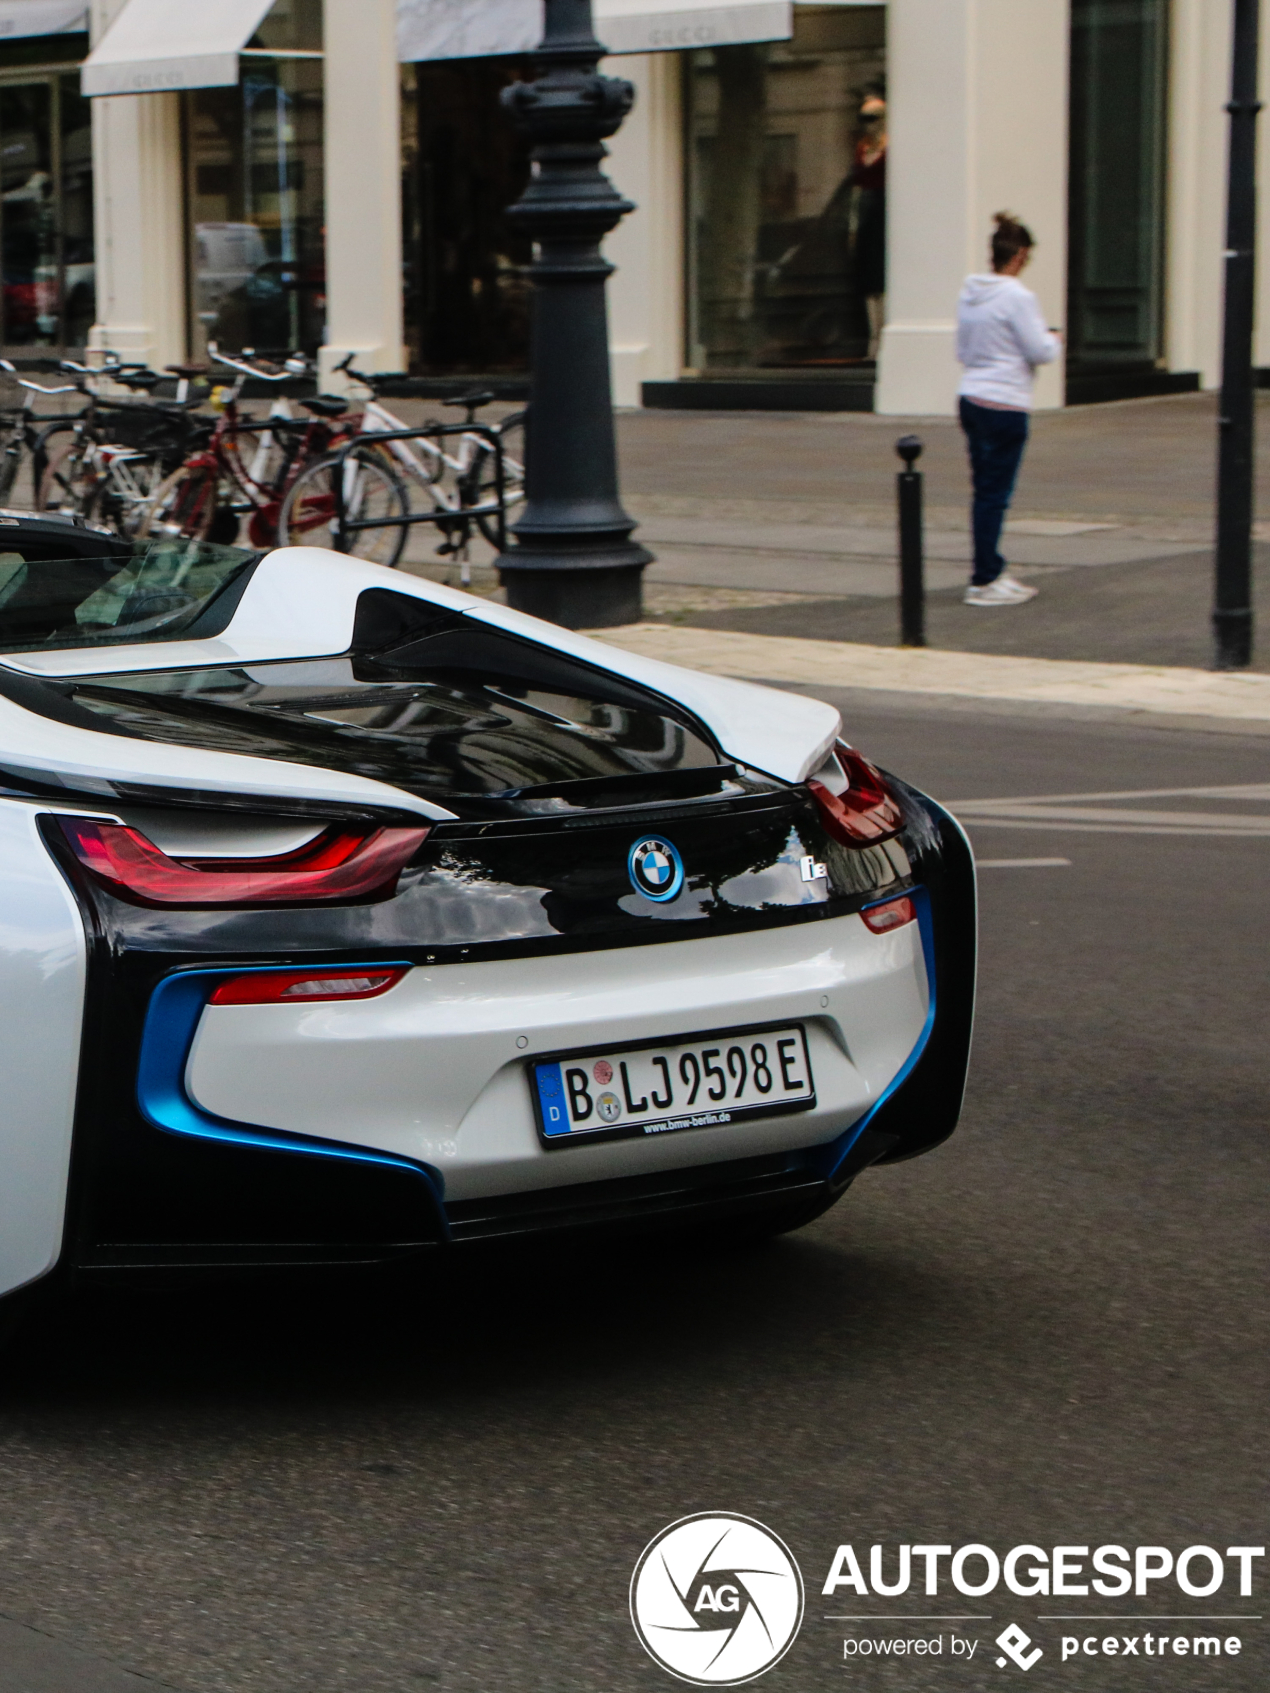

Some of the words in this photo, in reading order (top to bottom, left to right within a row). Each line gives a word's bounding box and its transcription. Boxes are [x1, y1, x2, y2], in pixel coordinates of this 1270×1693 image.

[634, 841, 672, 861] BMW
[565, 1067, 594, 1122] B
[548, 1106, 561, 1122] D
[642, 1111, 731, 1134] www.bmw-berlin.de
